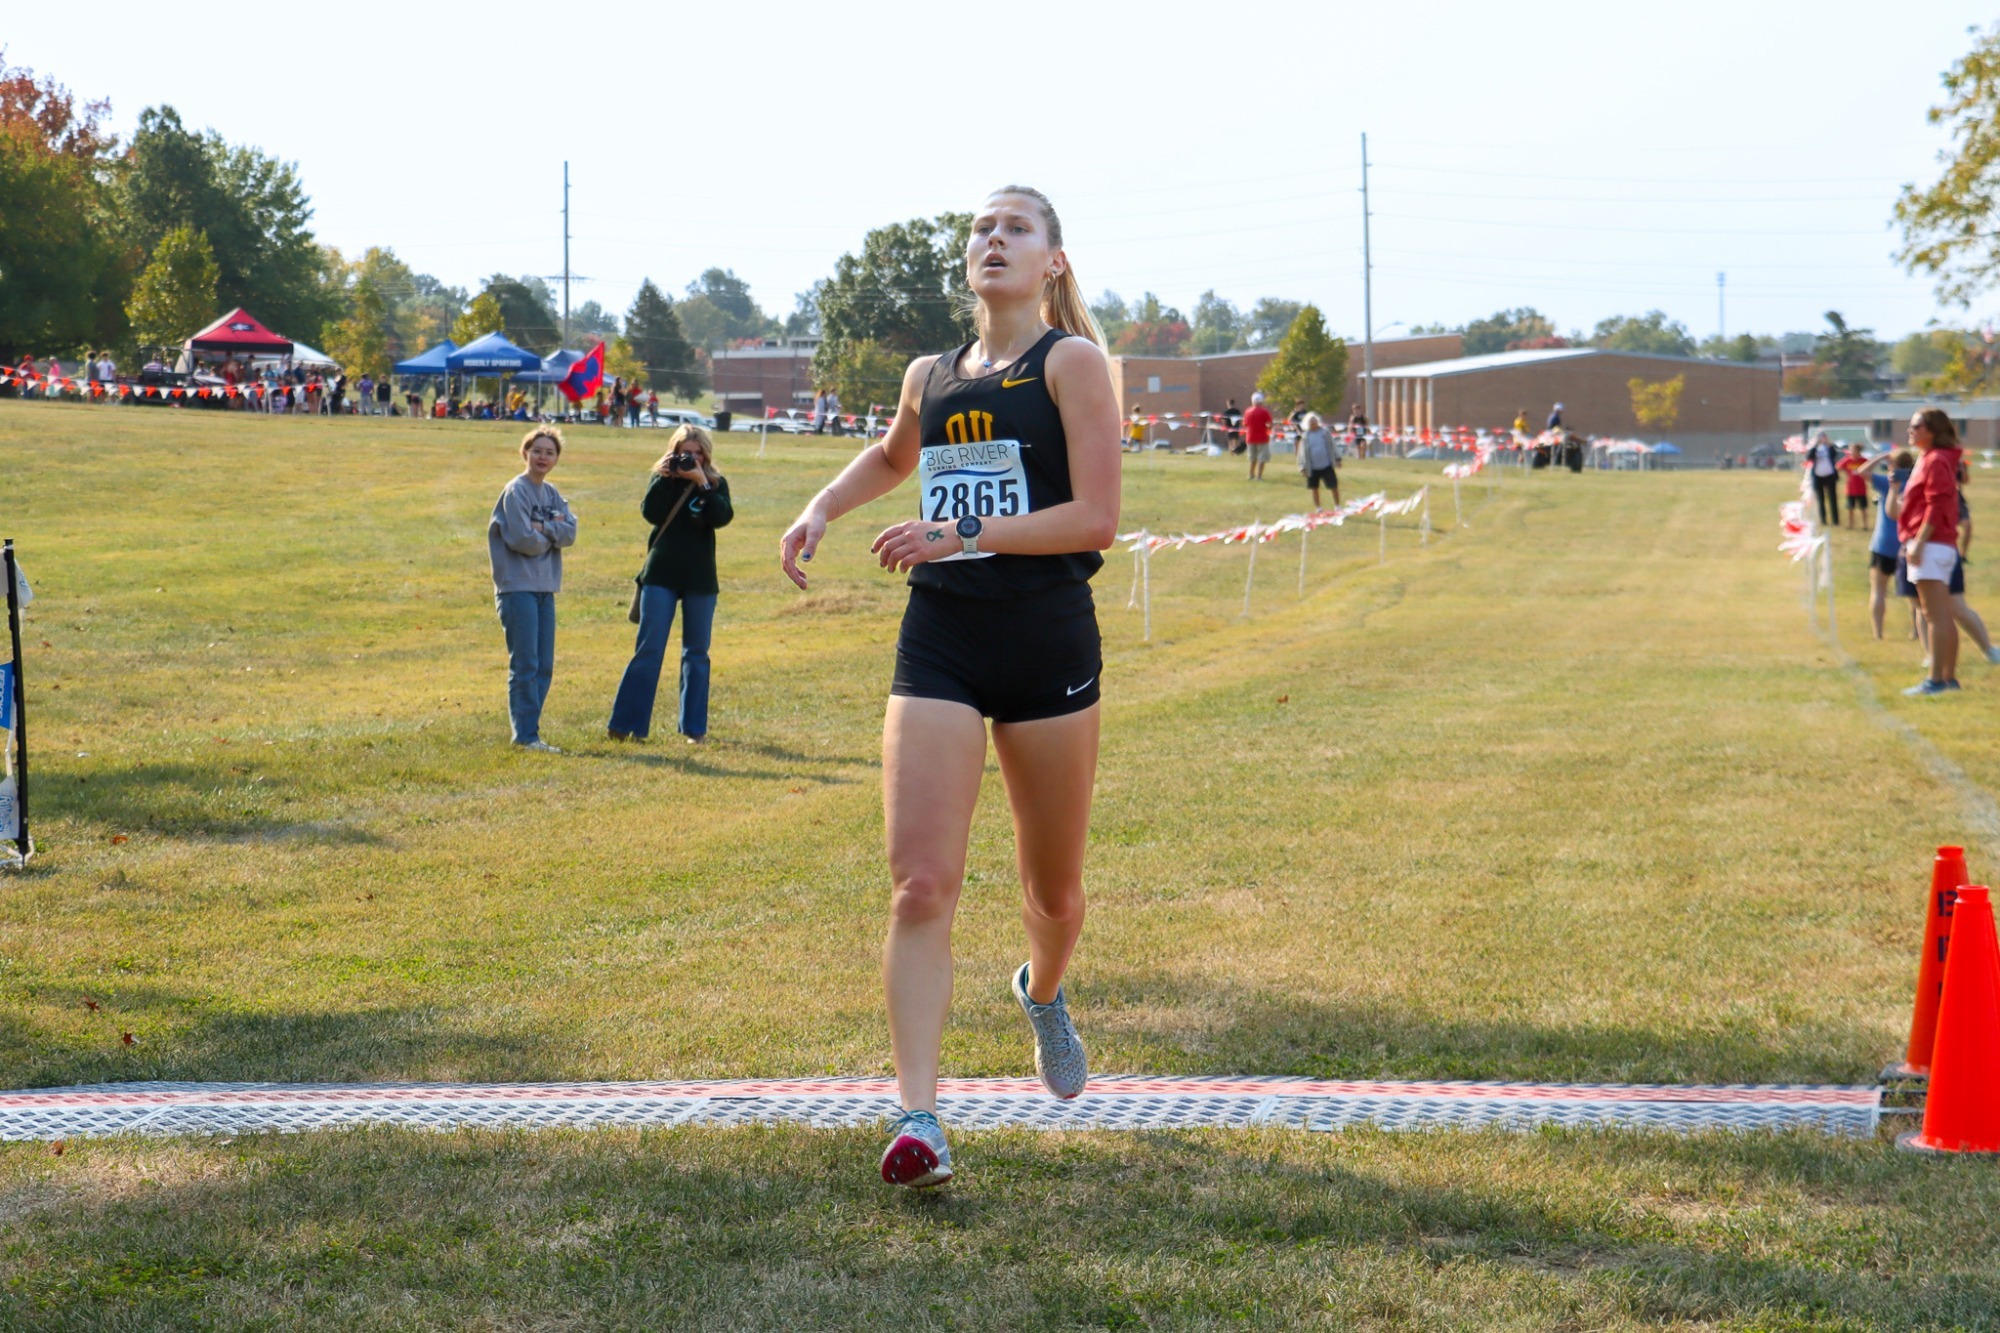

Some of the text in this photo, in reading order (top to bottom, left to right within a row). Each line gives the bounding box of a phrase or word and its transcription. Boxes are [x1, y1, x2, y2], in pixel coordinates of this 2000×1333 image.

[926, 443, 1009, 467] BIG RIVER
[928, 460, 992, 472] RUNNING COMPANY
[930, 478, 1019, 522] 2865
